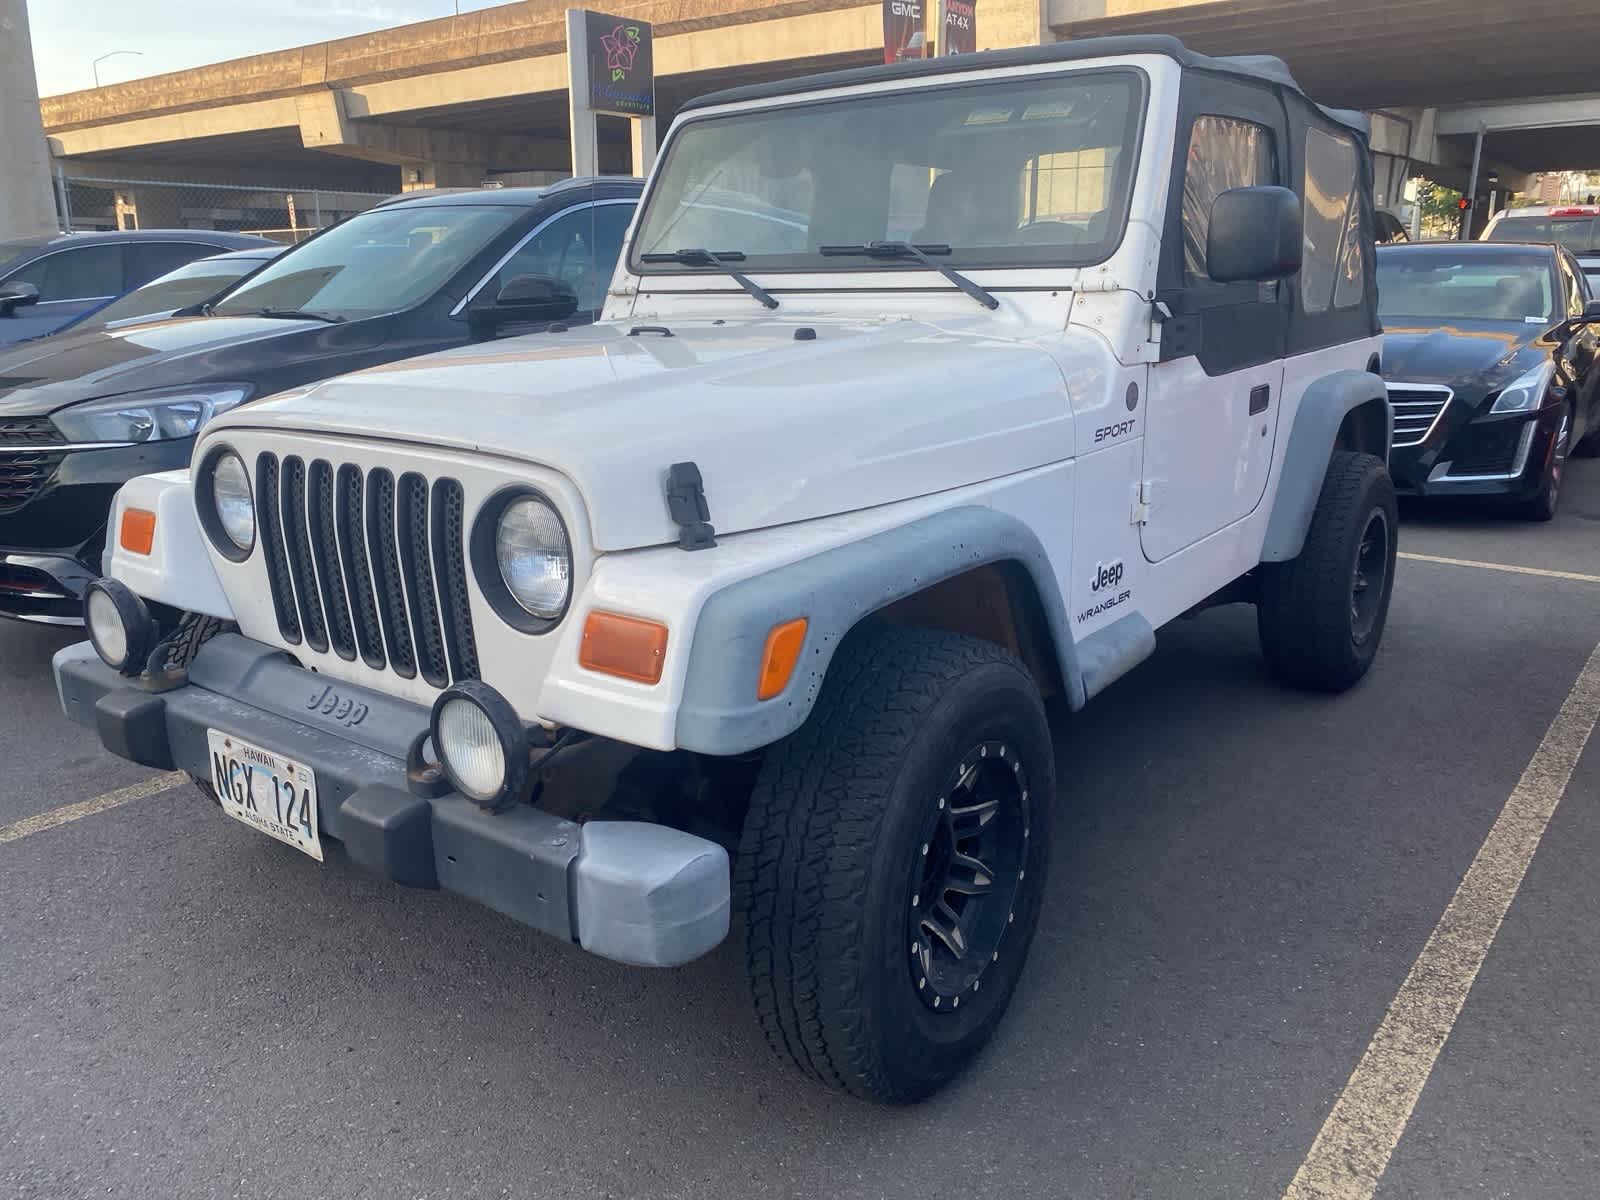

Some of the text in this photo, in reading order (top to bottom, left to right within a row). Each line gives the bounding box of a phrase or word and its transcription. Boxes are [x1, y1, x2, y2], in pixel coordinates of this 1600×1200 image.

[891, 2, 921, 19] GMC
[946, 0, 973, 16] ANYON
[945, 13, 969, 30] AT4X
[1094, 419, 1136, 443] SPORT
[1092, 562, 1123, 592] Jeep
[1077, 590, 1131, 624] WRANGLER
[306, 686, 369, 728] Jeep
[243, 748, 275, 768] HAWAII
[213, 752, 313, 839] NGX 124
[270, 821, 295, 841] STATE
